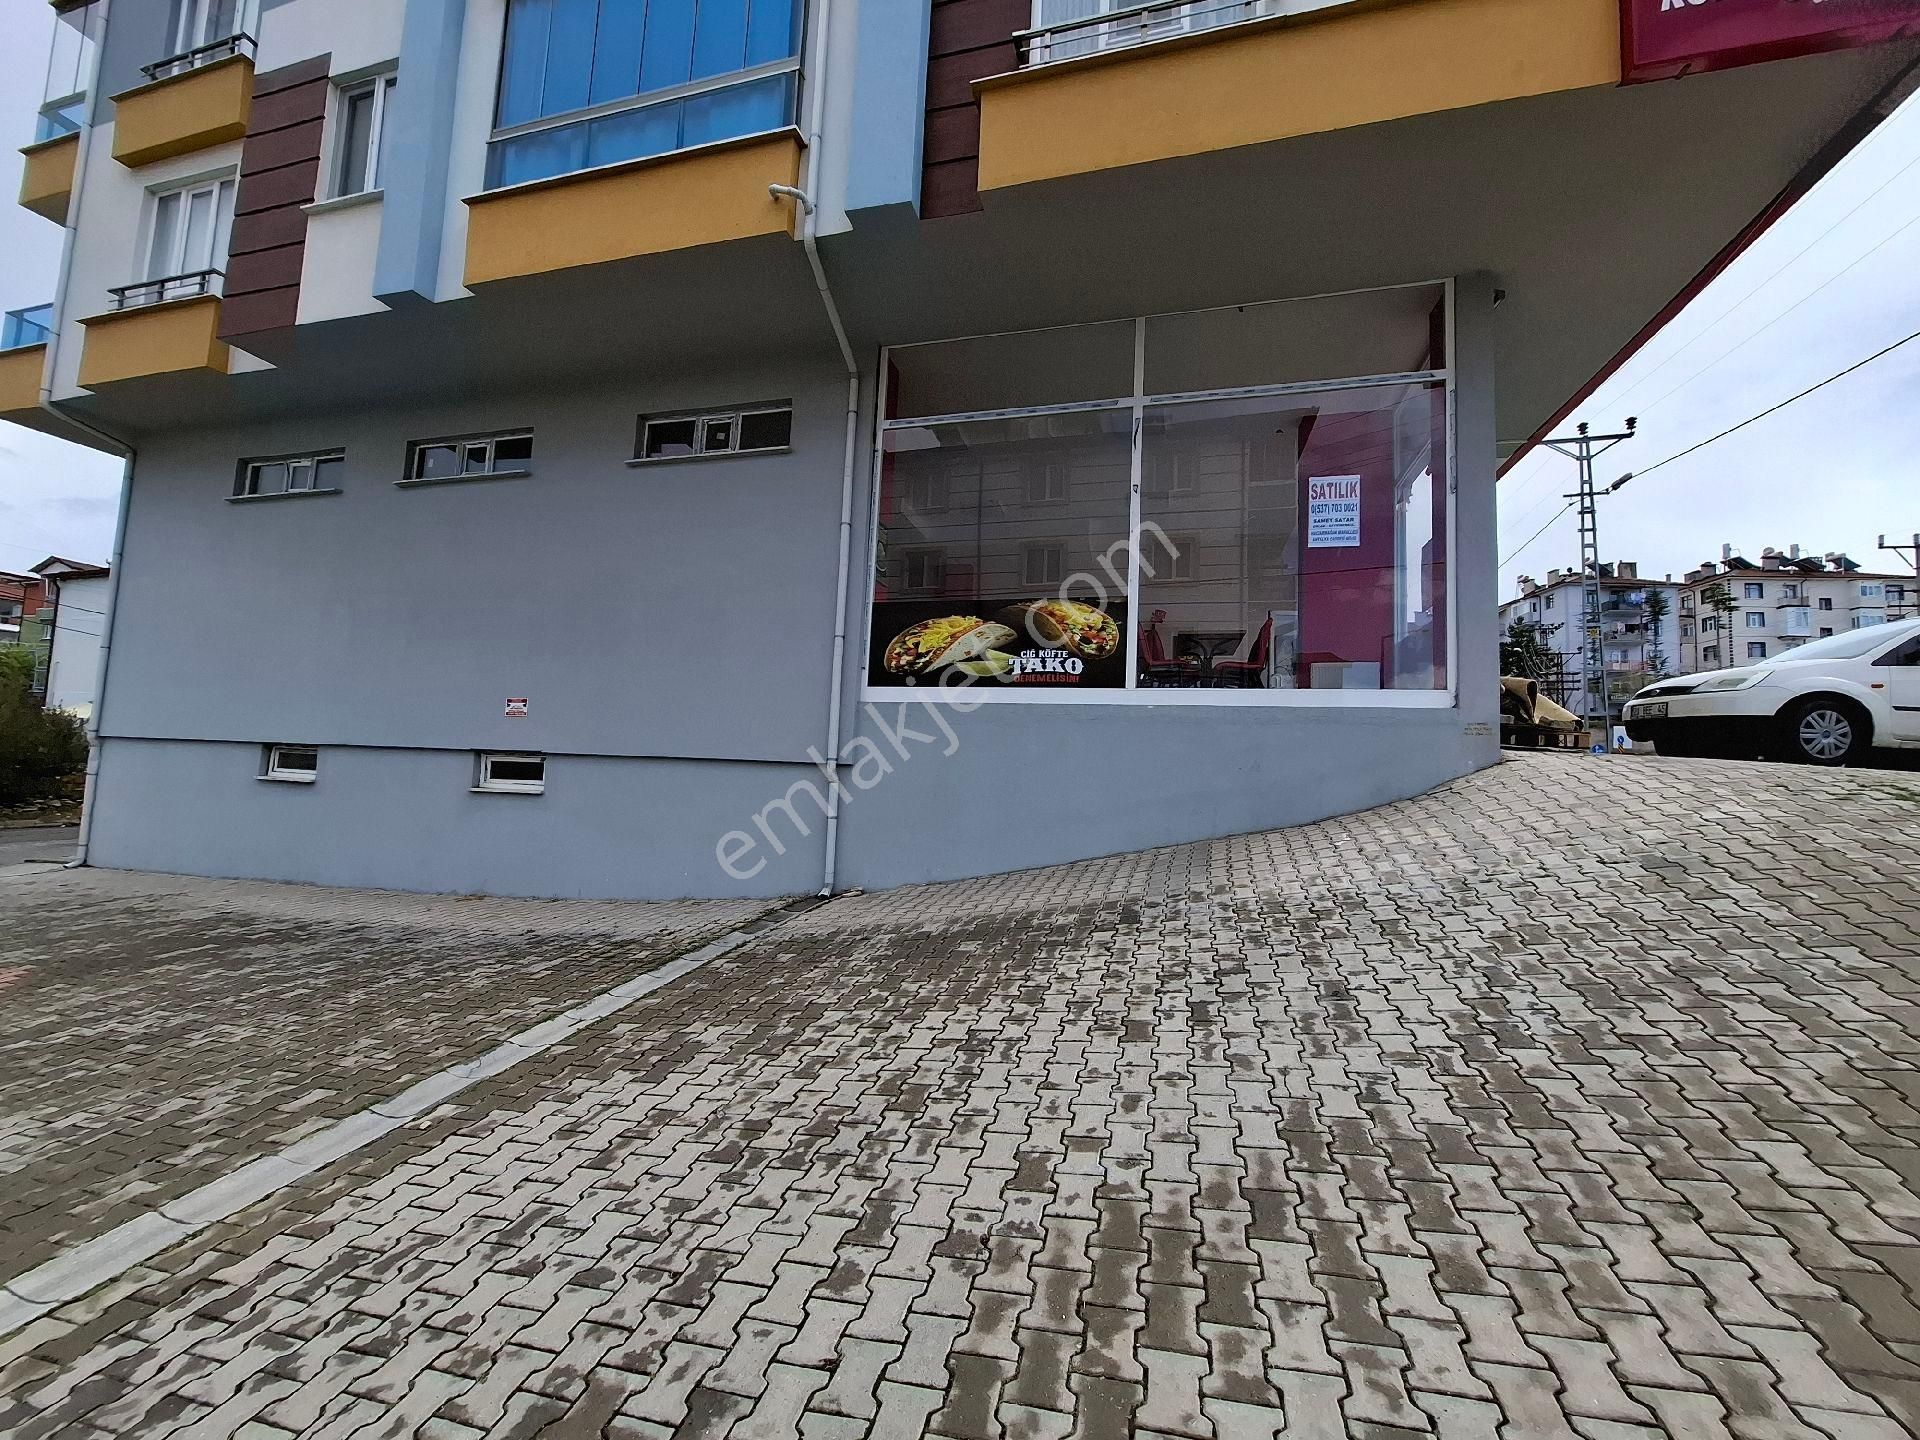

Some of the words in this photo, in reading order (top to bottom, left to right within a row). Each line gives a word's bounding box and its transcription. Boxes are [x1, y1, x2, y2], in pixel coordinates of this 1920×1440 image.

[1311, 481, 1358, 500] SATILIK
[1331, 503, 1343, 513] 703
[1038, 648, 1069, 658] KÖFTE
[1008, 657, 1084, 675] TAKO
